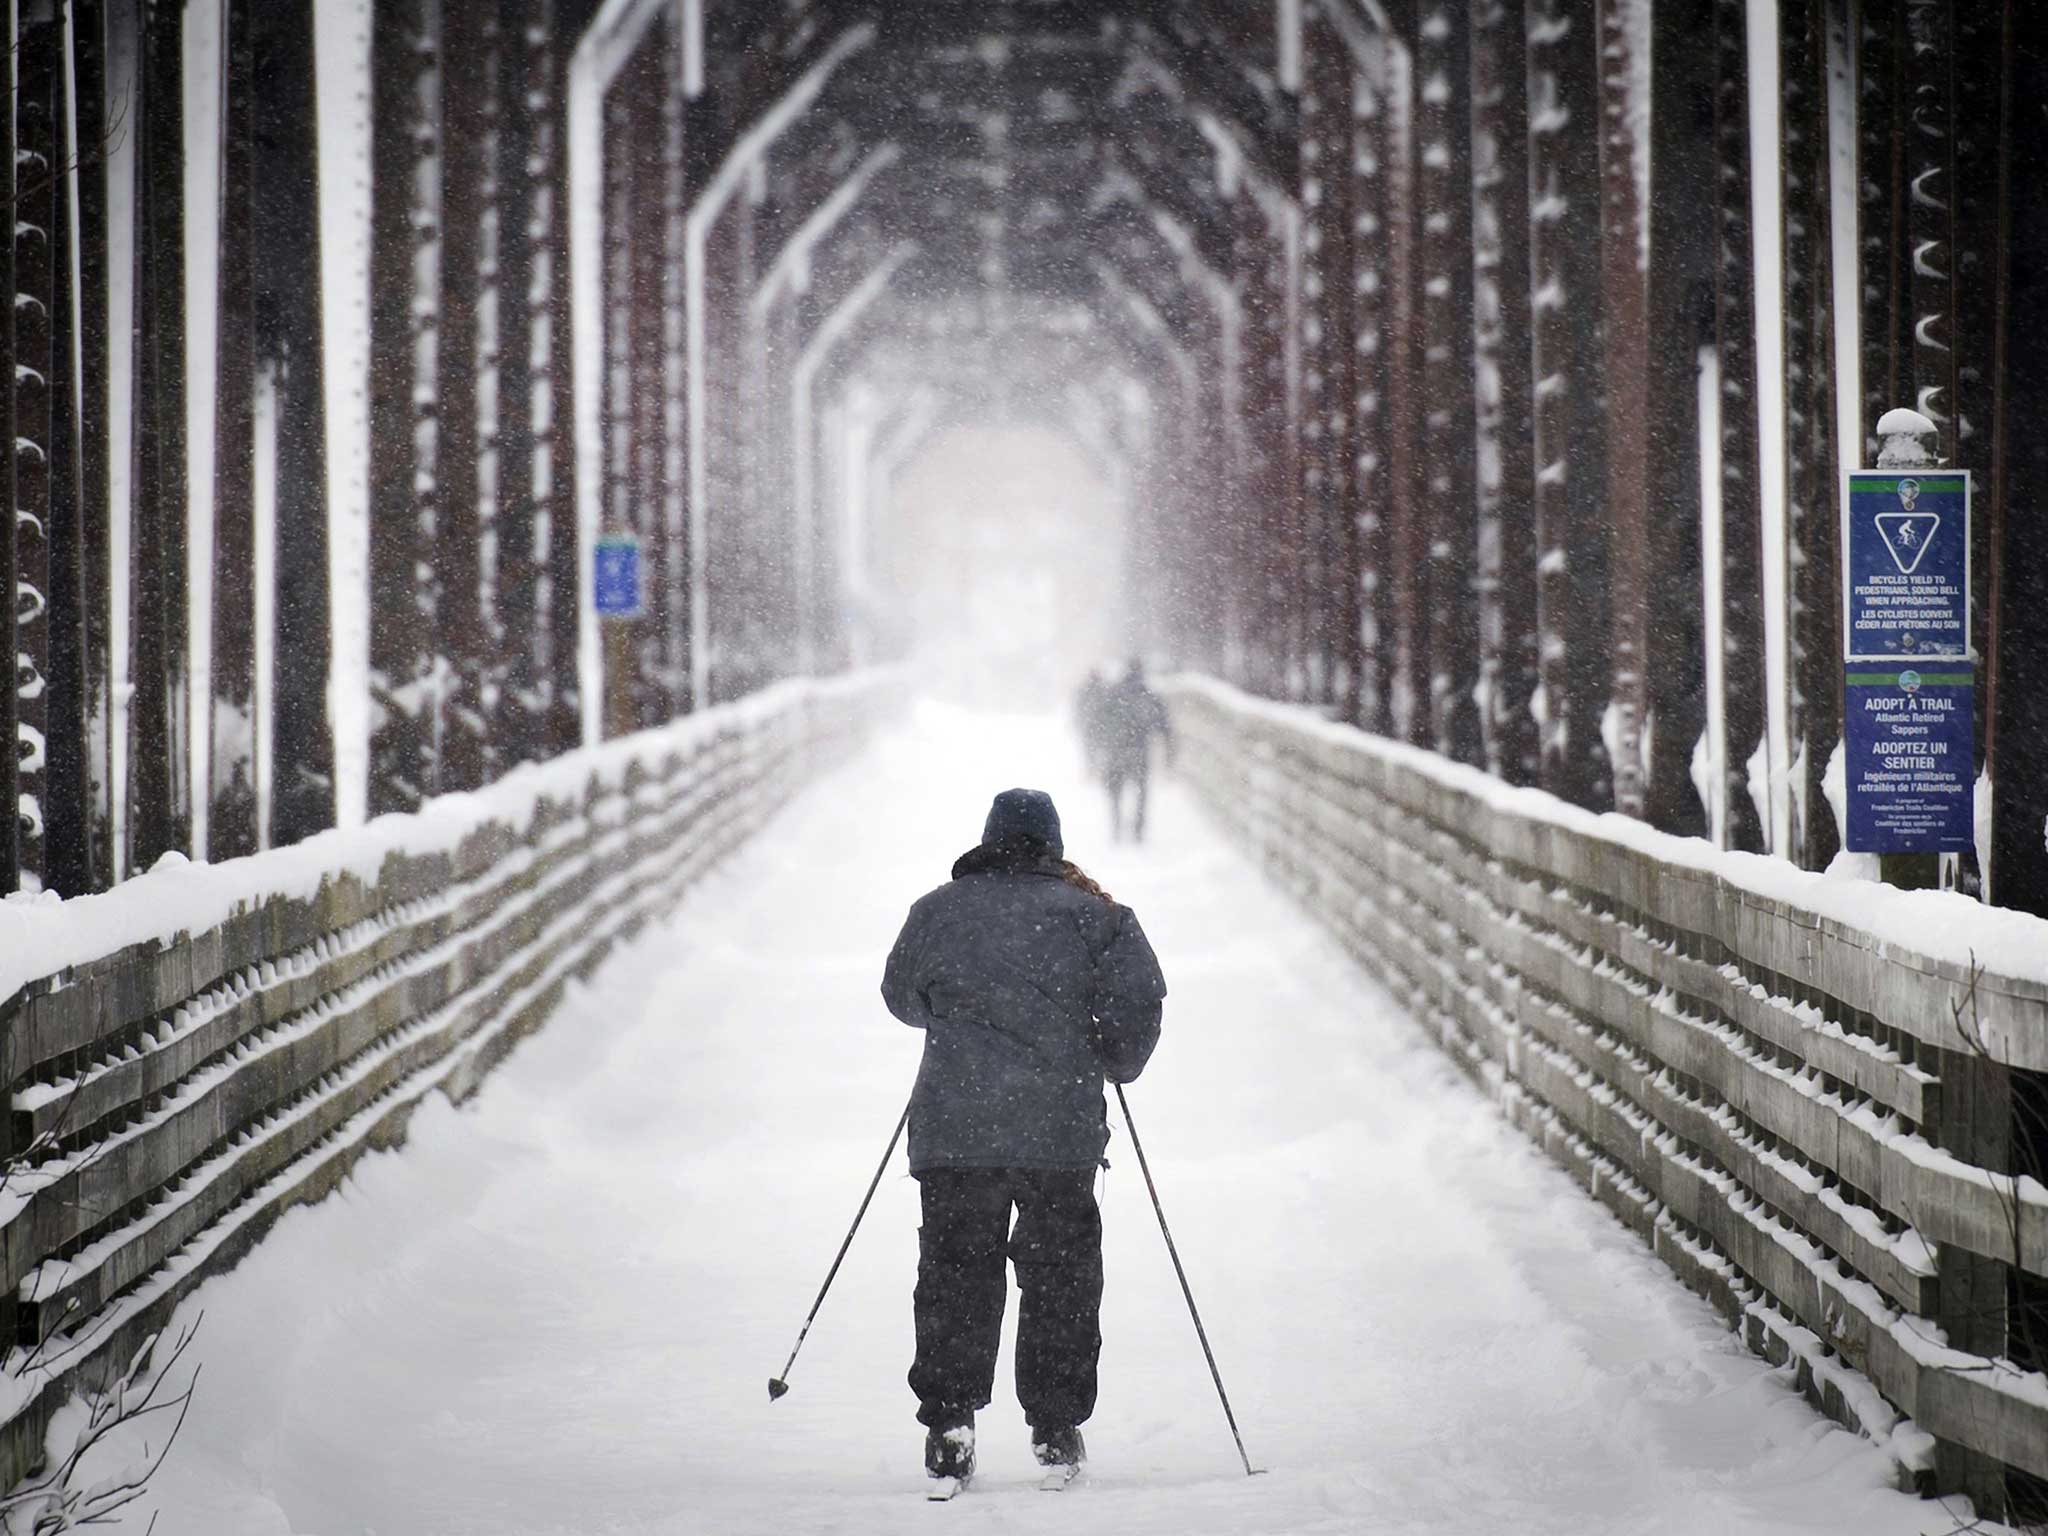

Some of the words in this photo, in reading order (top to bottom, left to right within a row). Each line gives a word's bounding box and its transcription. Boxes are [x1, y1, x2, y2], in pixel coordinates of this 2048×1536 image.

[1869, 576, 1908, 584] BICYCLES
[1910, 576, 1933, 584] YIELD
[1935, 576, 1946, 584] TO
[1855, 586, 1910, 595] PEDESTRIANS,
[1912, 586, 1939, 594] SOUND
[1940, 586, 1959, 594] BELL
[1865, 597, 1889, 605] WHEN
[1891, 597, 1949, 605] APPROACHING.
[1862, 610, 1876, 618] LES
[1877, 610, 1918, 618] CYCLISTES
[1920, 610, 1953, 618] DOIVENT
[1855, 619, 1880, 629] CÉDER
[1882, 621, 1897, 629] AUX
[1932, 621, 1943, 629] AU
[1944, 621, 1960, 629] SON
[1865, 698, 1905, 710] ADOPT
[1908, 698, 1918, 710] A
[1920, 698, 1955, 710] TRAIL
[1875, 713, 1910, 722] Atlantic
[1912, 713, 1945, 722] Retired
[1891, 725, 1928, 736] Sappers
[1872, 742, 1927, 754] ADOPTEZ
[1930, 742, 1947, 754] UN
[1884, 757, 1935, 769] SENTIER
[1864, 771, 1912, 782] Ingénieurs
[1913, 771, 1956, 781] militaires
[1858, 783, 1896, 792] retraités
[1897, 783, 1909, 792] de
[1910, 783, 1963, 793] l'Atlantique
